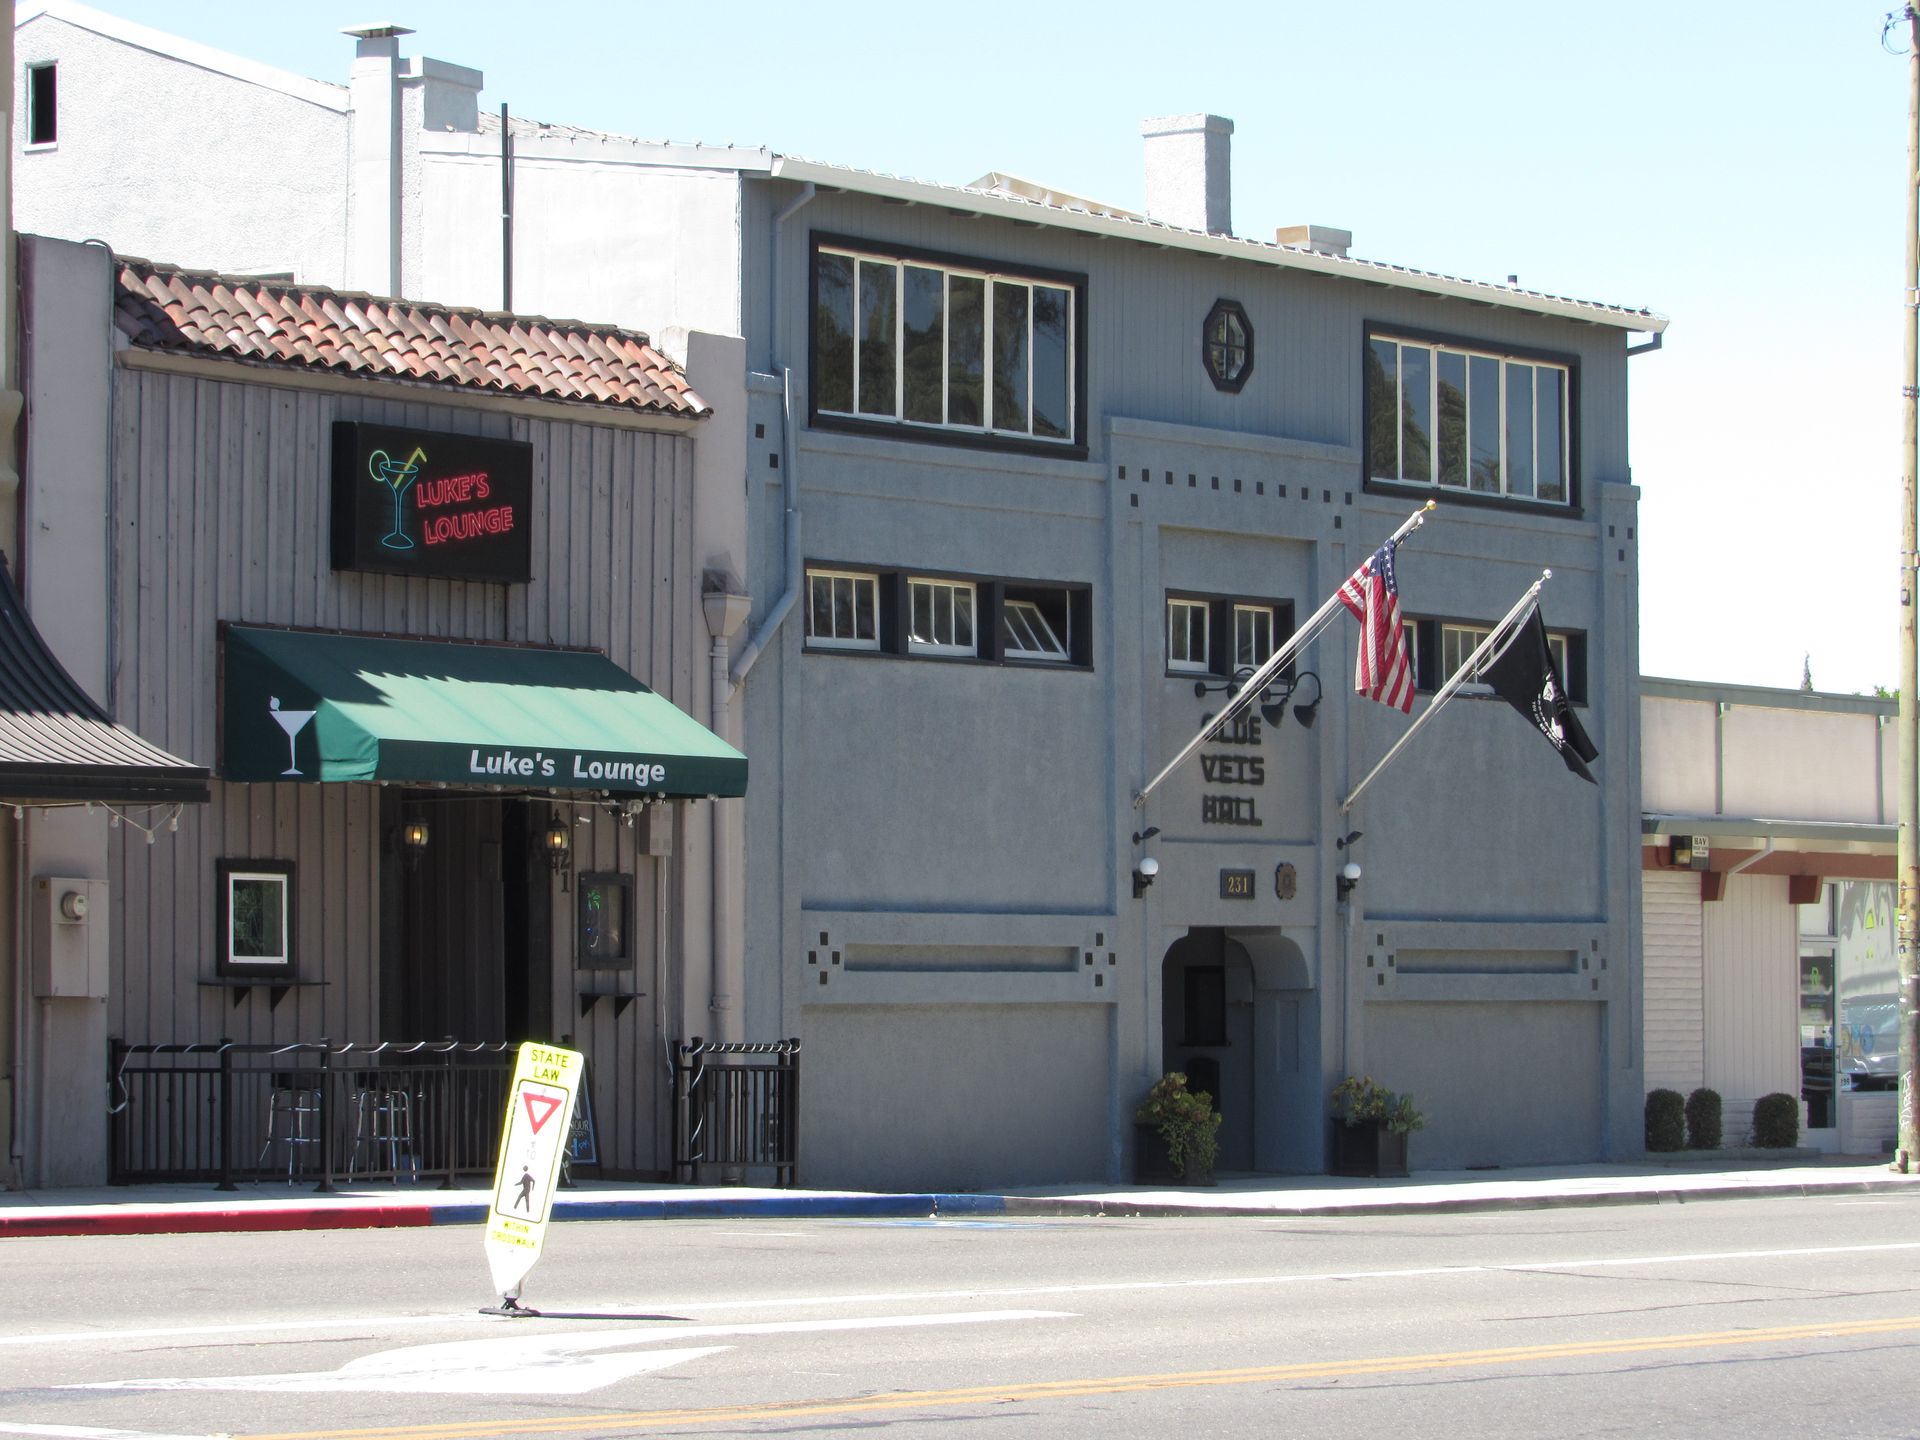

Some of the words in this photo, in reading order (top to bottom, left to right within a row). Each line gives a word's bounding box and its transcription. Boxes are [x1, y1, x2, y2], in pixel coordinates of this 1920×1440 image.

[417, 473, 490, 508] LUKE'S
[424, 506, 514, 545] LOUNGE
[470, 749, 555, 777] Luke's
[573, 755, 665, 787] Lounge
[1200, 754, 1265, 786] VETS
[1202, 794, 1263, 826] HALL
[1228, 876, 1248, 893] 231
[531, 1049, 569, 1068] STATE
[534, 1068, 560, 1082] LAW
